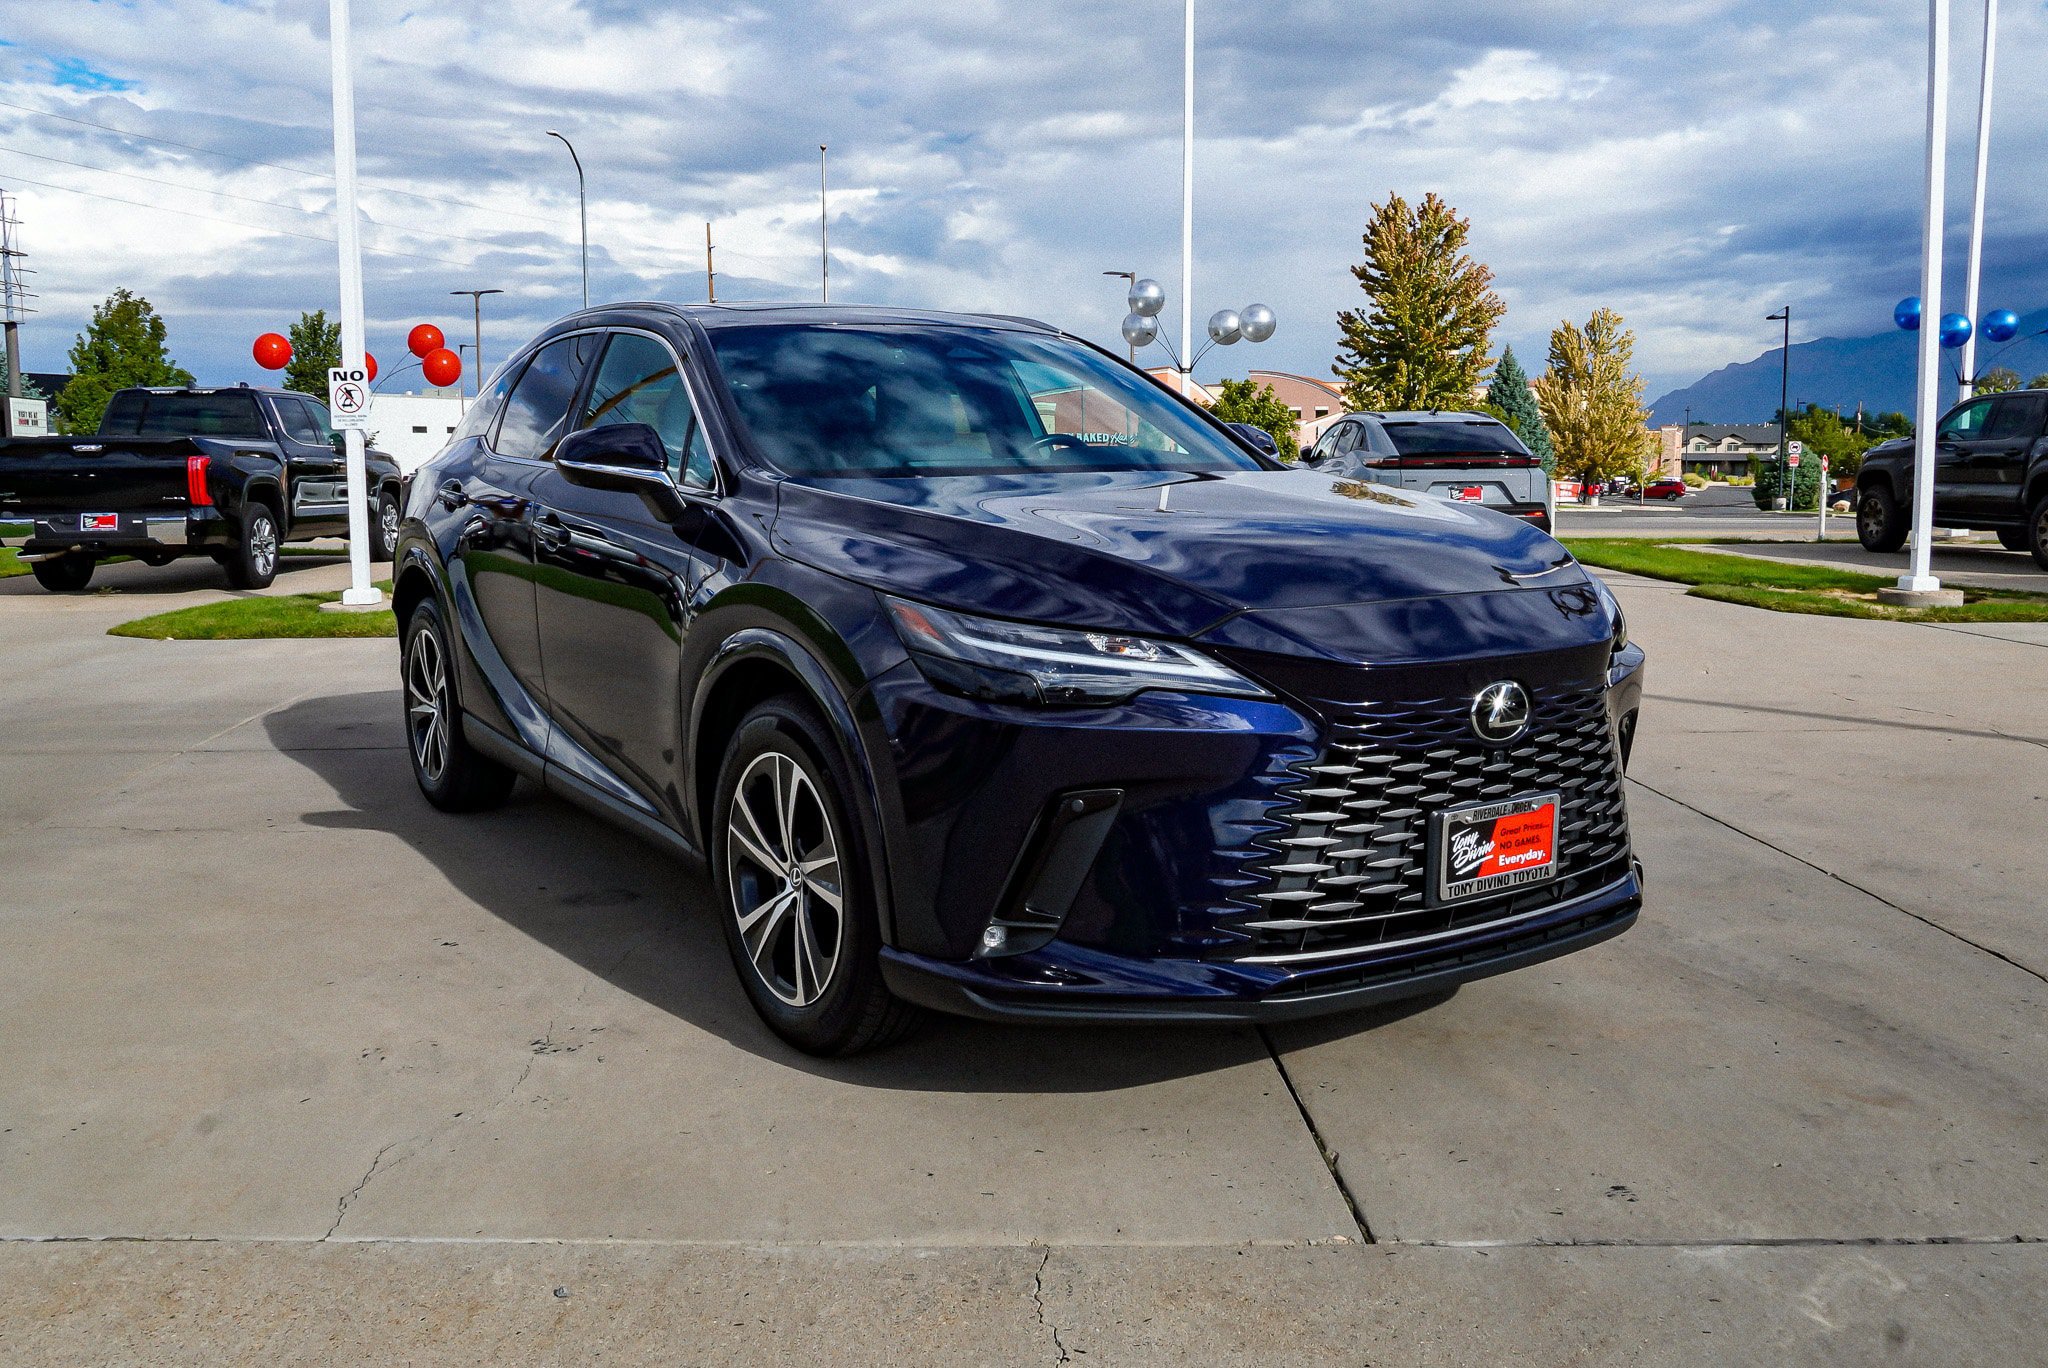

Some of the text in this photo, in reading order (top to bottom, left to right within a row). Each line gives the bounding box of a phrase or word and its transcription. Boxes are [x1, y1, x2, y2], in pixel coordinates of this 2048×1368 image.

[333, 371, 364, 381] NO
[1077, 433, 1109, 443] BAKED
[1473, 805, 1507, 821] RIVERDALE
[1500, 826, 1521, 837] Great
[1451, 828, 1479, 852] Tony
[1500, 841, 1512, 850] NO
[1451, 840, 1496, 868] Divino
[1498, 849, 1545, 866] Everyday.
[1448, 866, 1550, 898] TONY DIVINO TOYOTA
